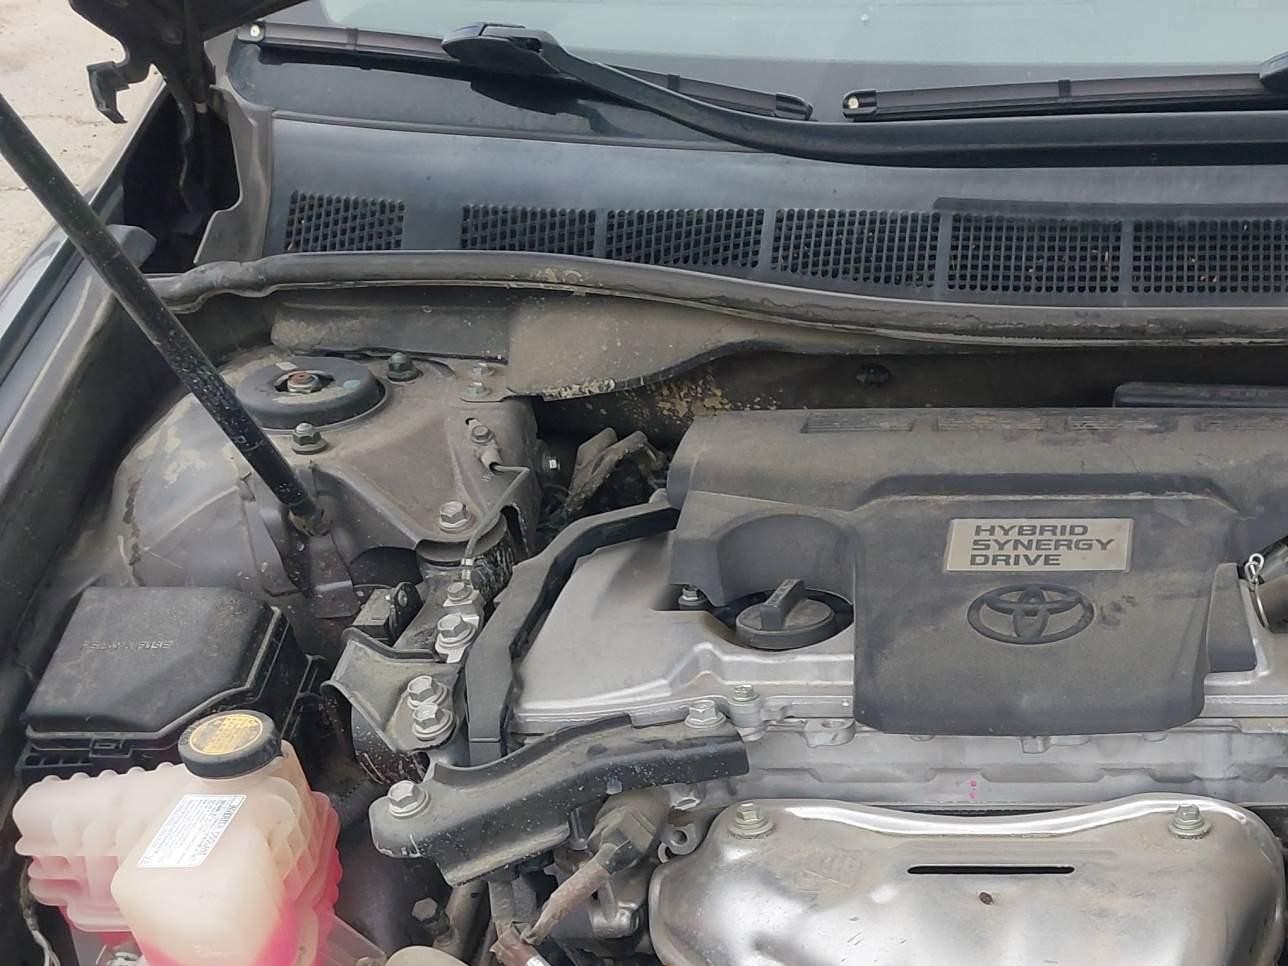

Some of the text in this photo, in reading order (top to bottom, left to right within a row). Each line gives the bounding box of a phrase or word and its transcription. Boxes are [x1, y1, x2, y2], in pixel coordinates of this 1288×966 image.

[974, 524, 1089, 536] HYBRID
[971, 538, 1115, 551] SYNERGY
[969, 554, 1062, 566] DRIVE
